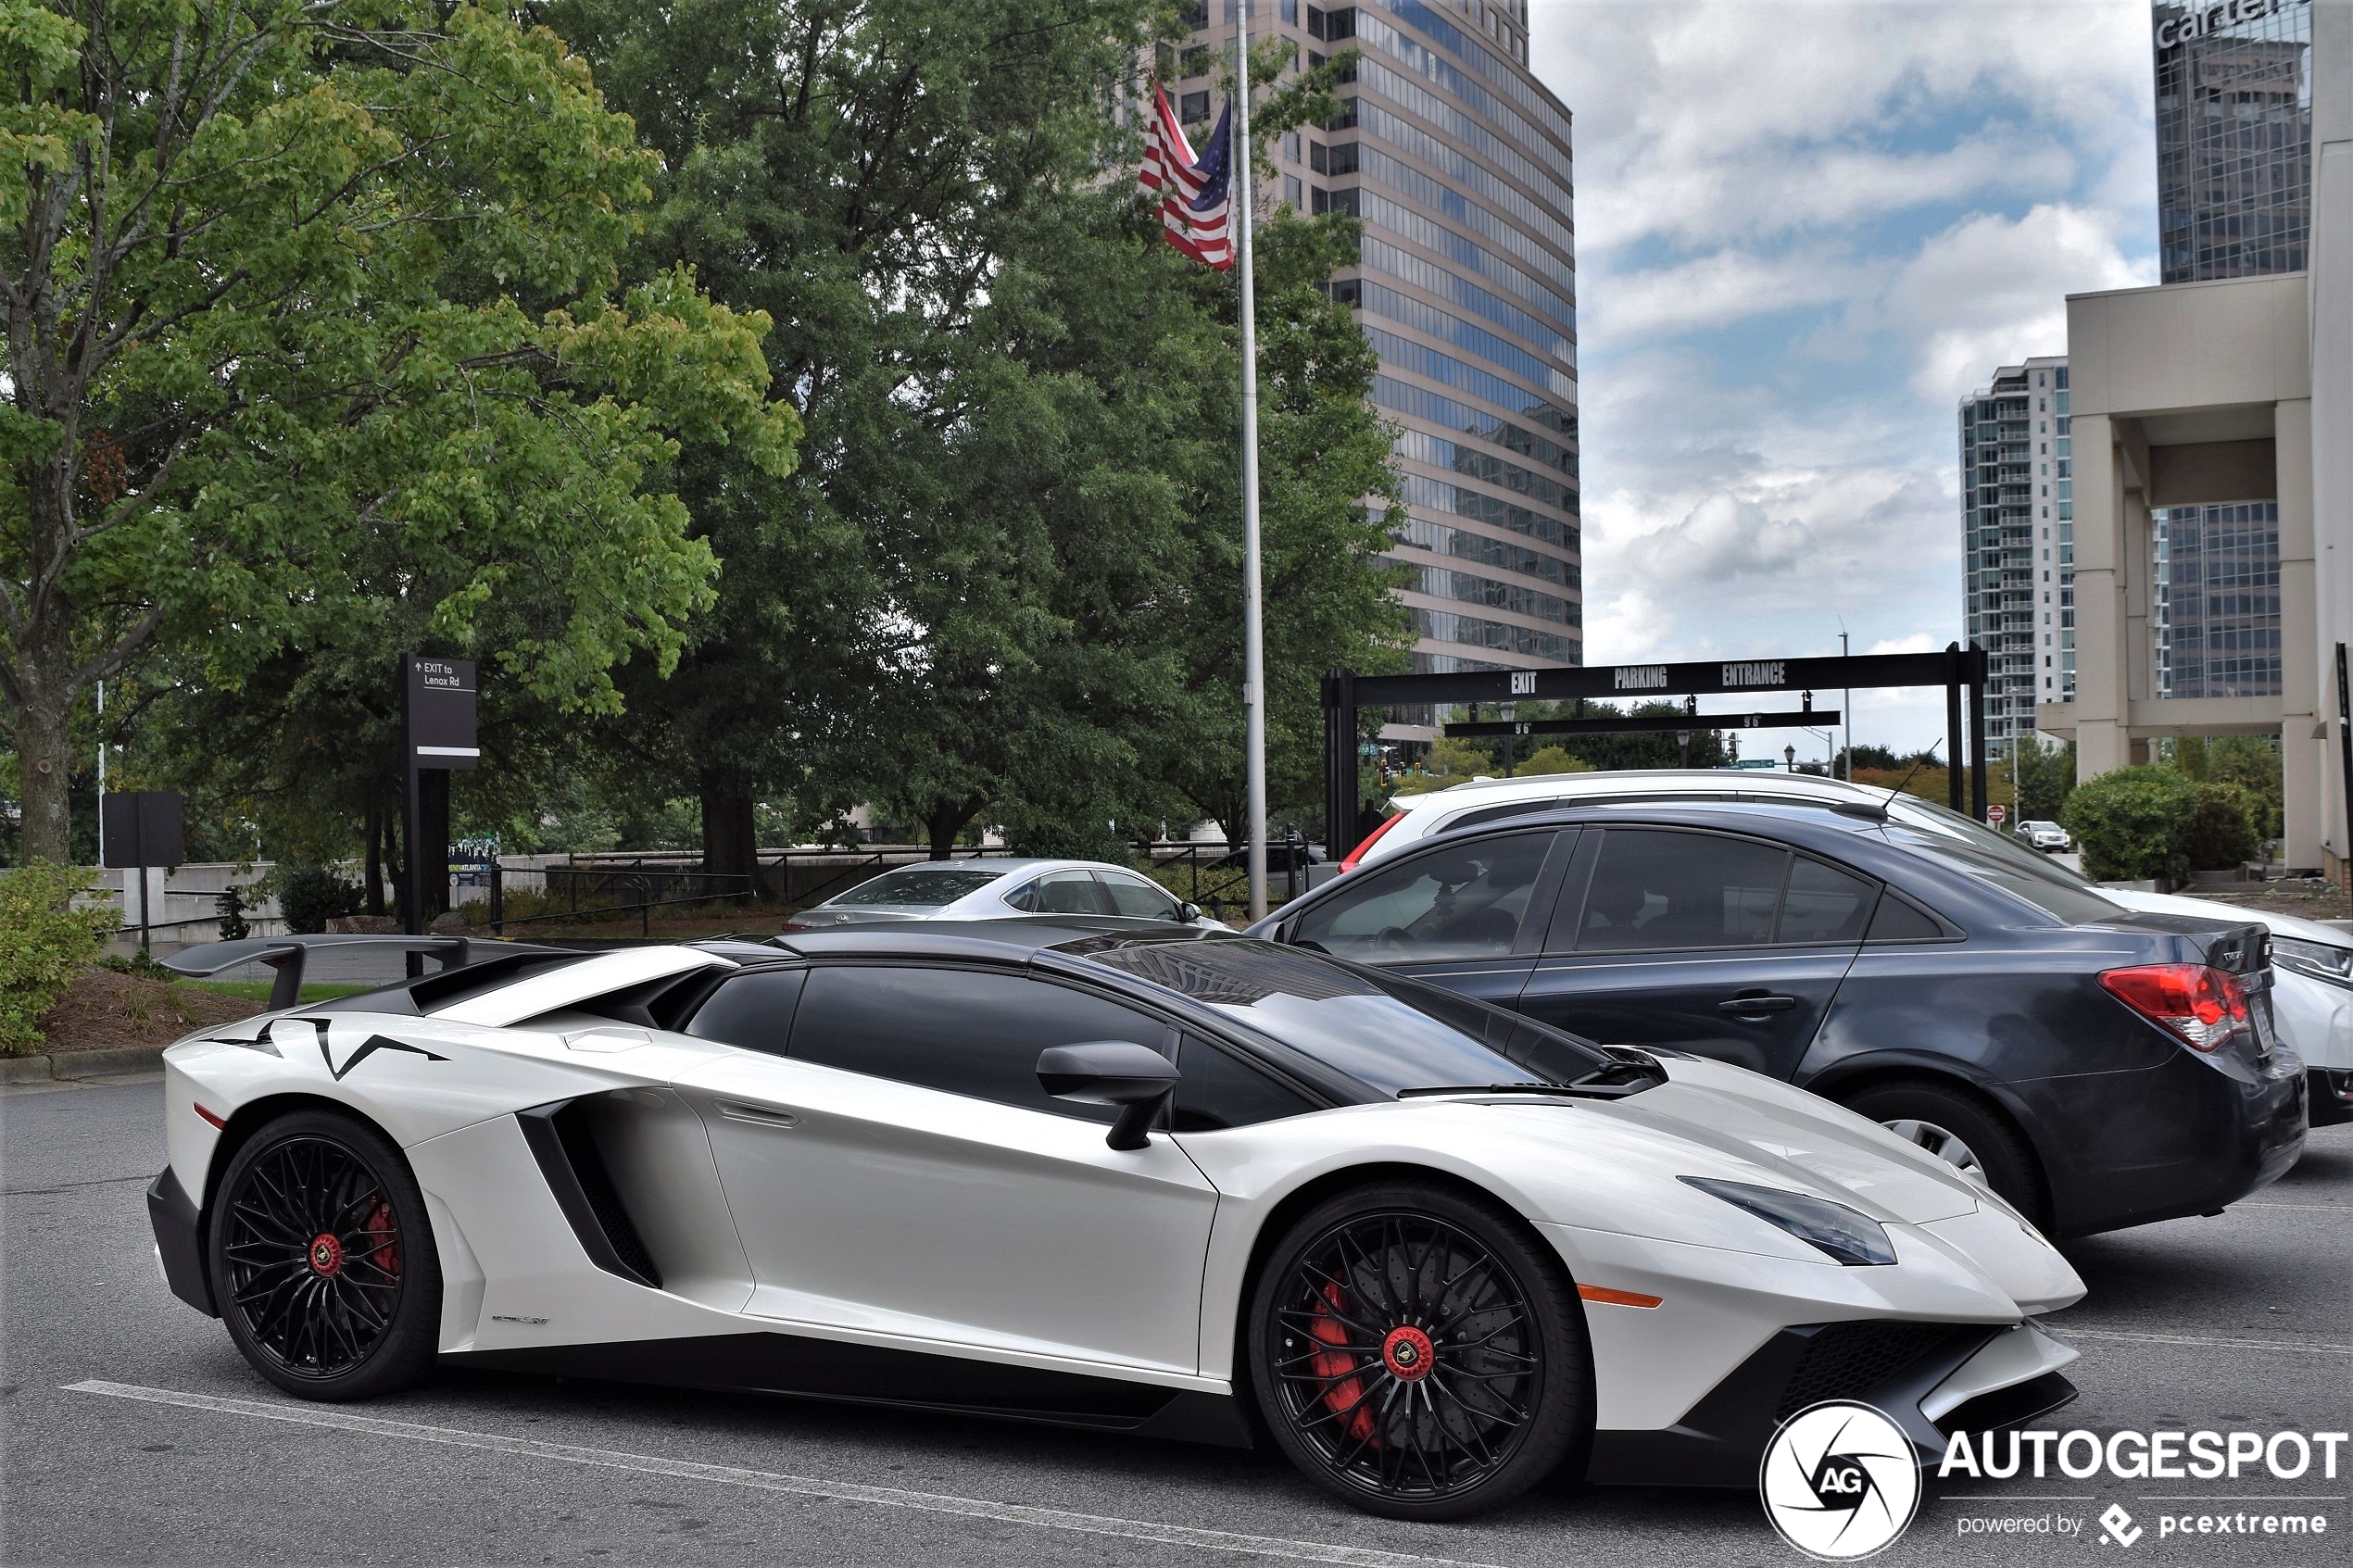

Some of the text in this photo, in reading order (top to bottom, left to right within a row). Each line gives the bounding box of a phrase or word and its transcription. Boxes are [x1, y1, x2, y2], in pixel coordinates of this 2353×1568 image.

[424, 662, 453, 674] EXIT to
[424, 675, 459, 686] Lenox Rd
[1511, 661, 1785, 694] EXIT PARKING ENTRANCE
